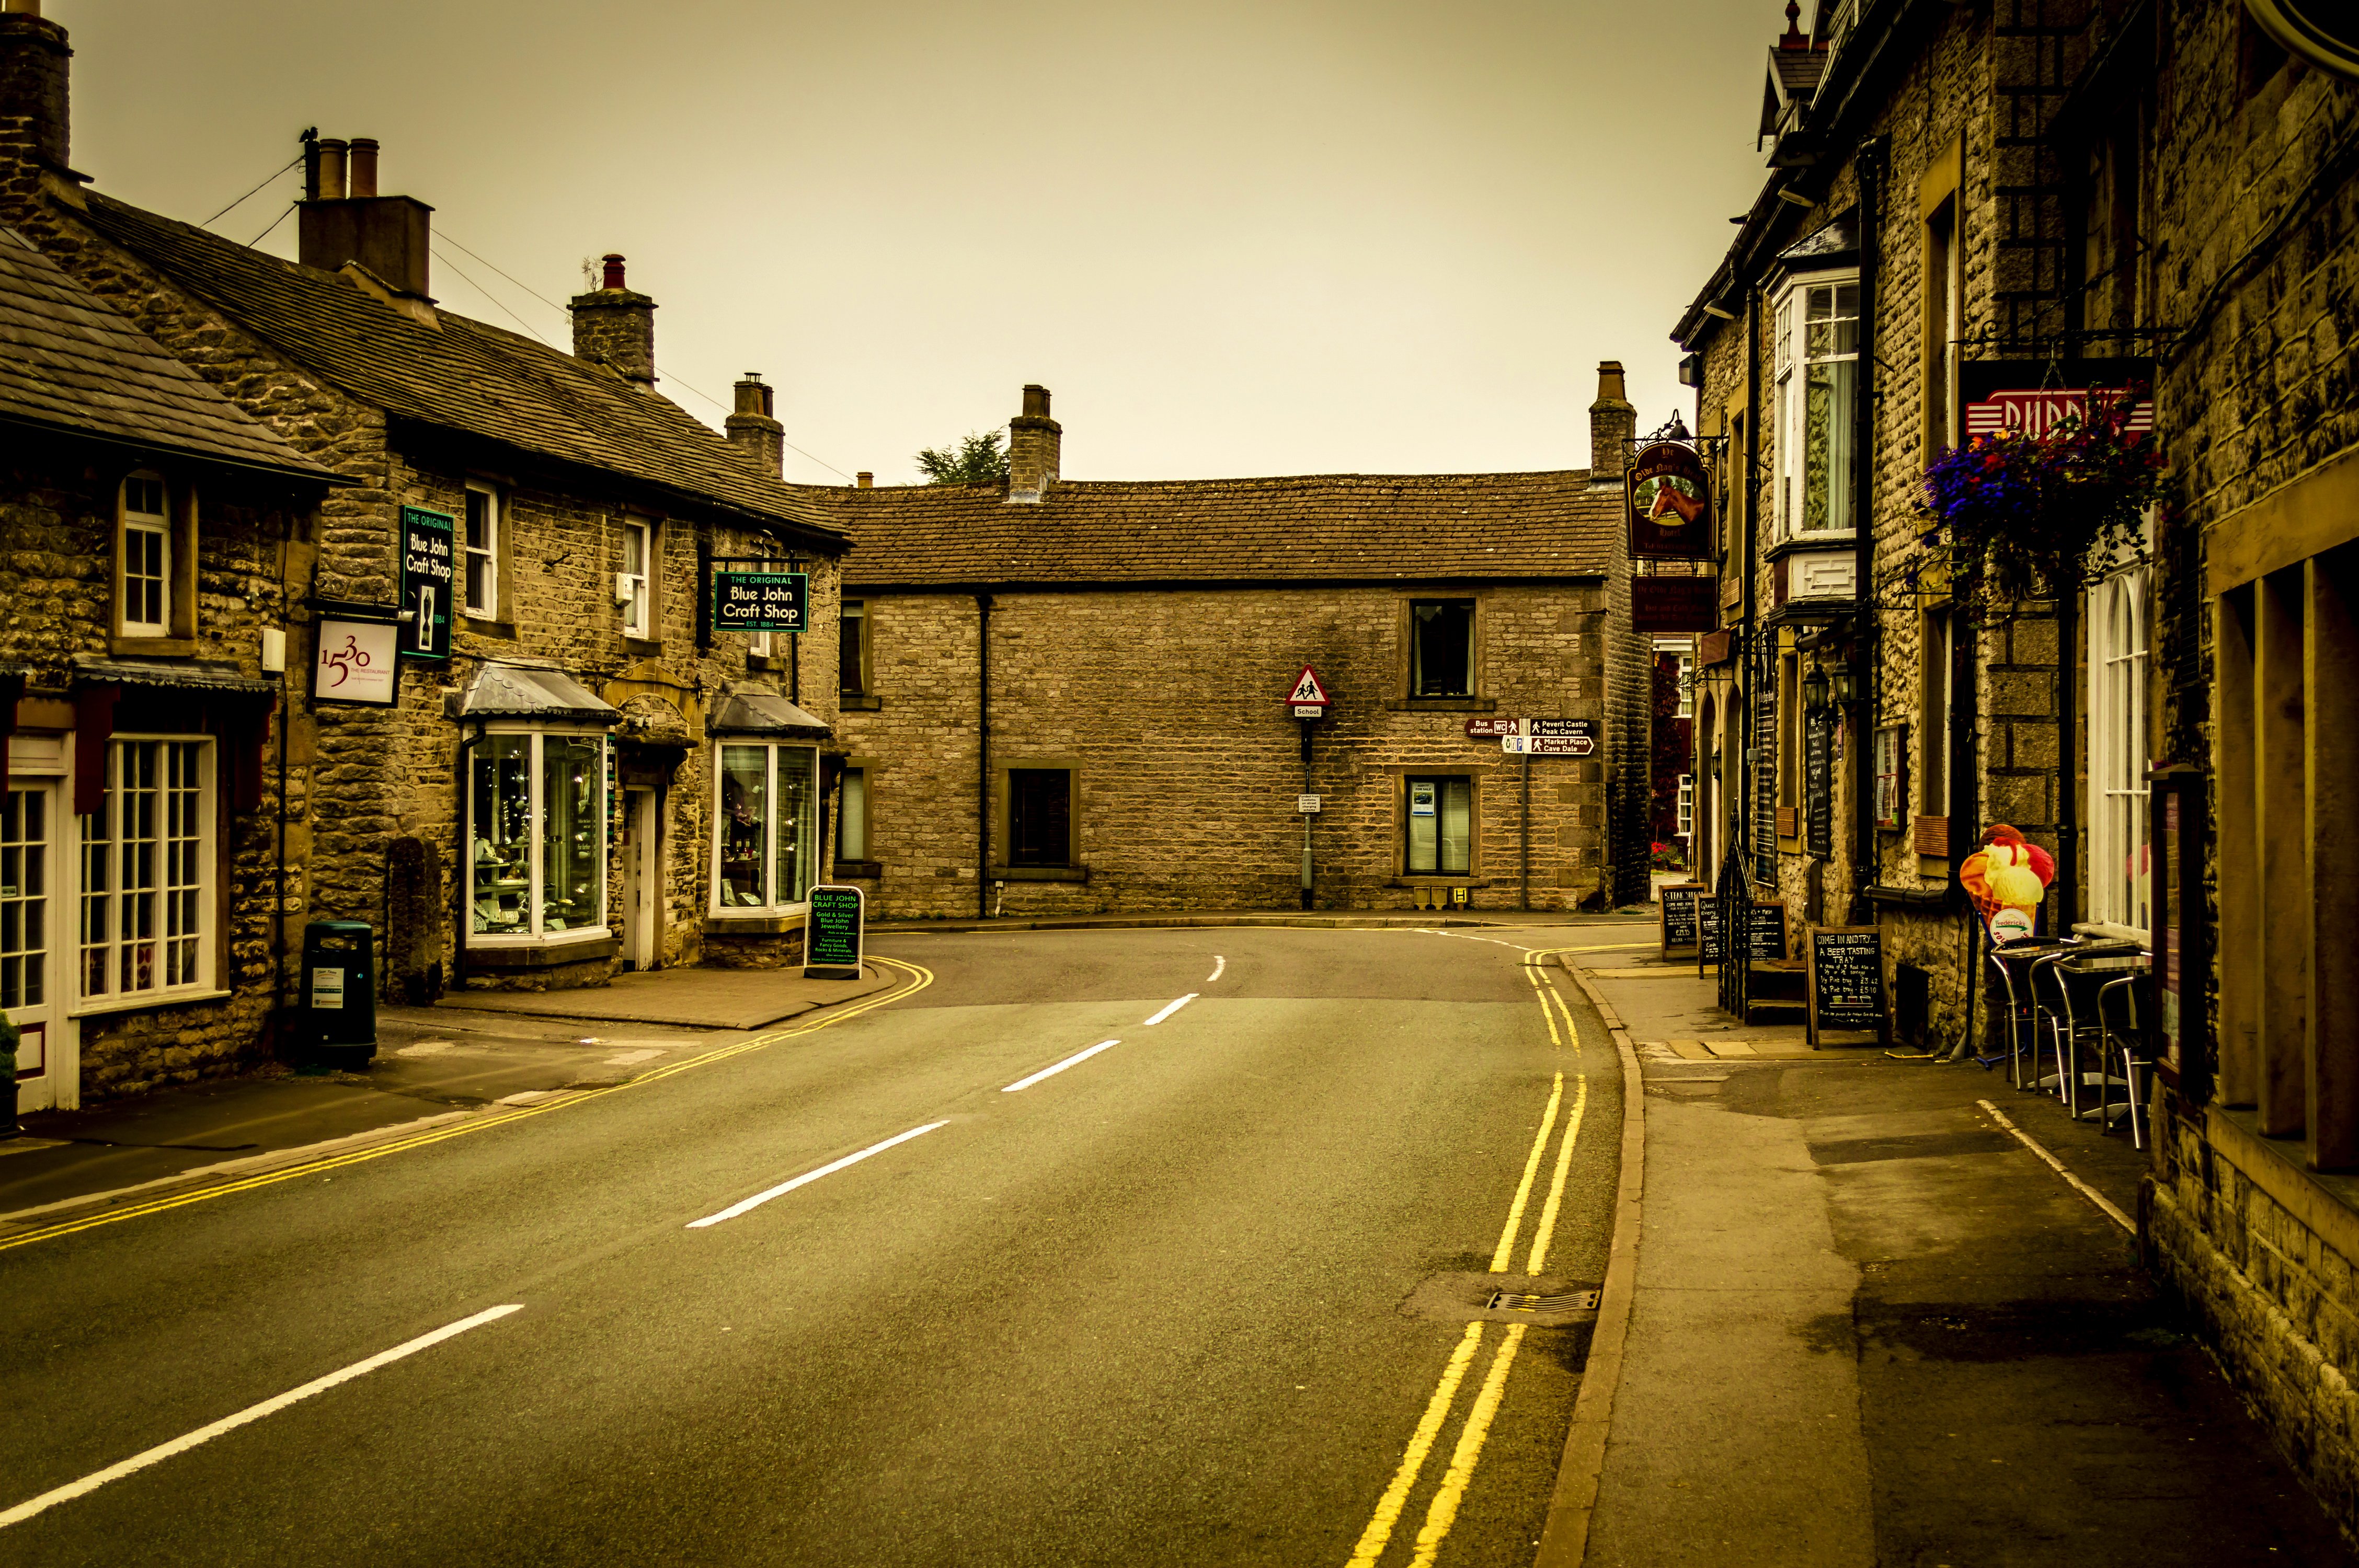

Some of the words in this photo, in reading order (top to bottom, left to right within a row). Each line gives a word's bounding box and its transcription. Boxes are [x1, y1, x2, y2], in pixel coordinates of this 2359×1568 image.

[1662, 447, 1674, 458] Ye
[1635, 467, 1653, 481] Olde
[1656, 464, 1680, 472] Nag's
[408, 513, 418, 524] THE
[421, 516, 452, 531] ORIGINAL
[1659, 527, 1681, 537] Hotel
[411, 534, 428, 552] Blue
[429, 537, 448, 557] John
[407, 555, 429, 574] Craft
[431, 559, 451, 583] Shop
[730, 586, 758, 600] Blue
[762, 587, 792, 601] John
[723, 603, 760, 617] Craft
[764, 604, 798, 622] Shop
[434, 614, 444, 624] 1884
[320, 635, 371, 688] 1530
[1456, 890, 1464, 901] H
[1665, 892, 1684, 900] STEAK
[1700, 901, 1715, 910] Quiz
[1817, 935, 1835, 945] COME
[1837, 935, 1845, 944] IN
[1819, 948, 1825, 956] A
[1827, 948, 1846, 956] BEER
[1842, 977, 1852, 986] tray
[1843, 986, 1853, 996] tray
